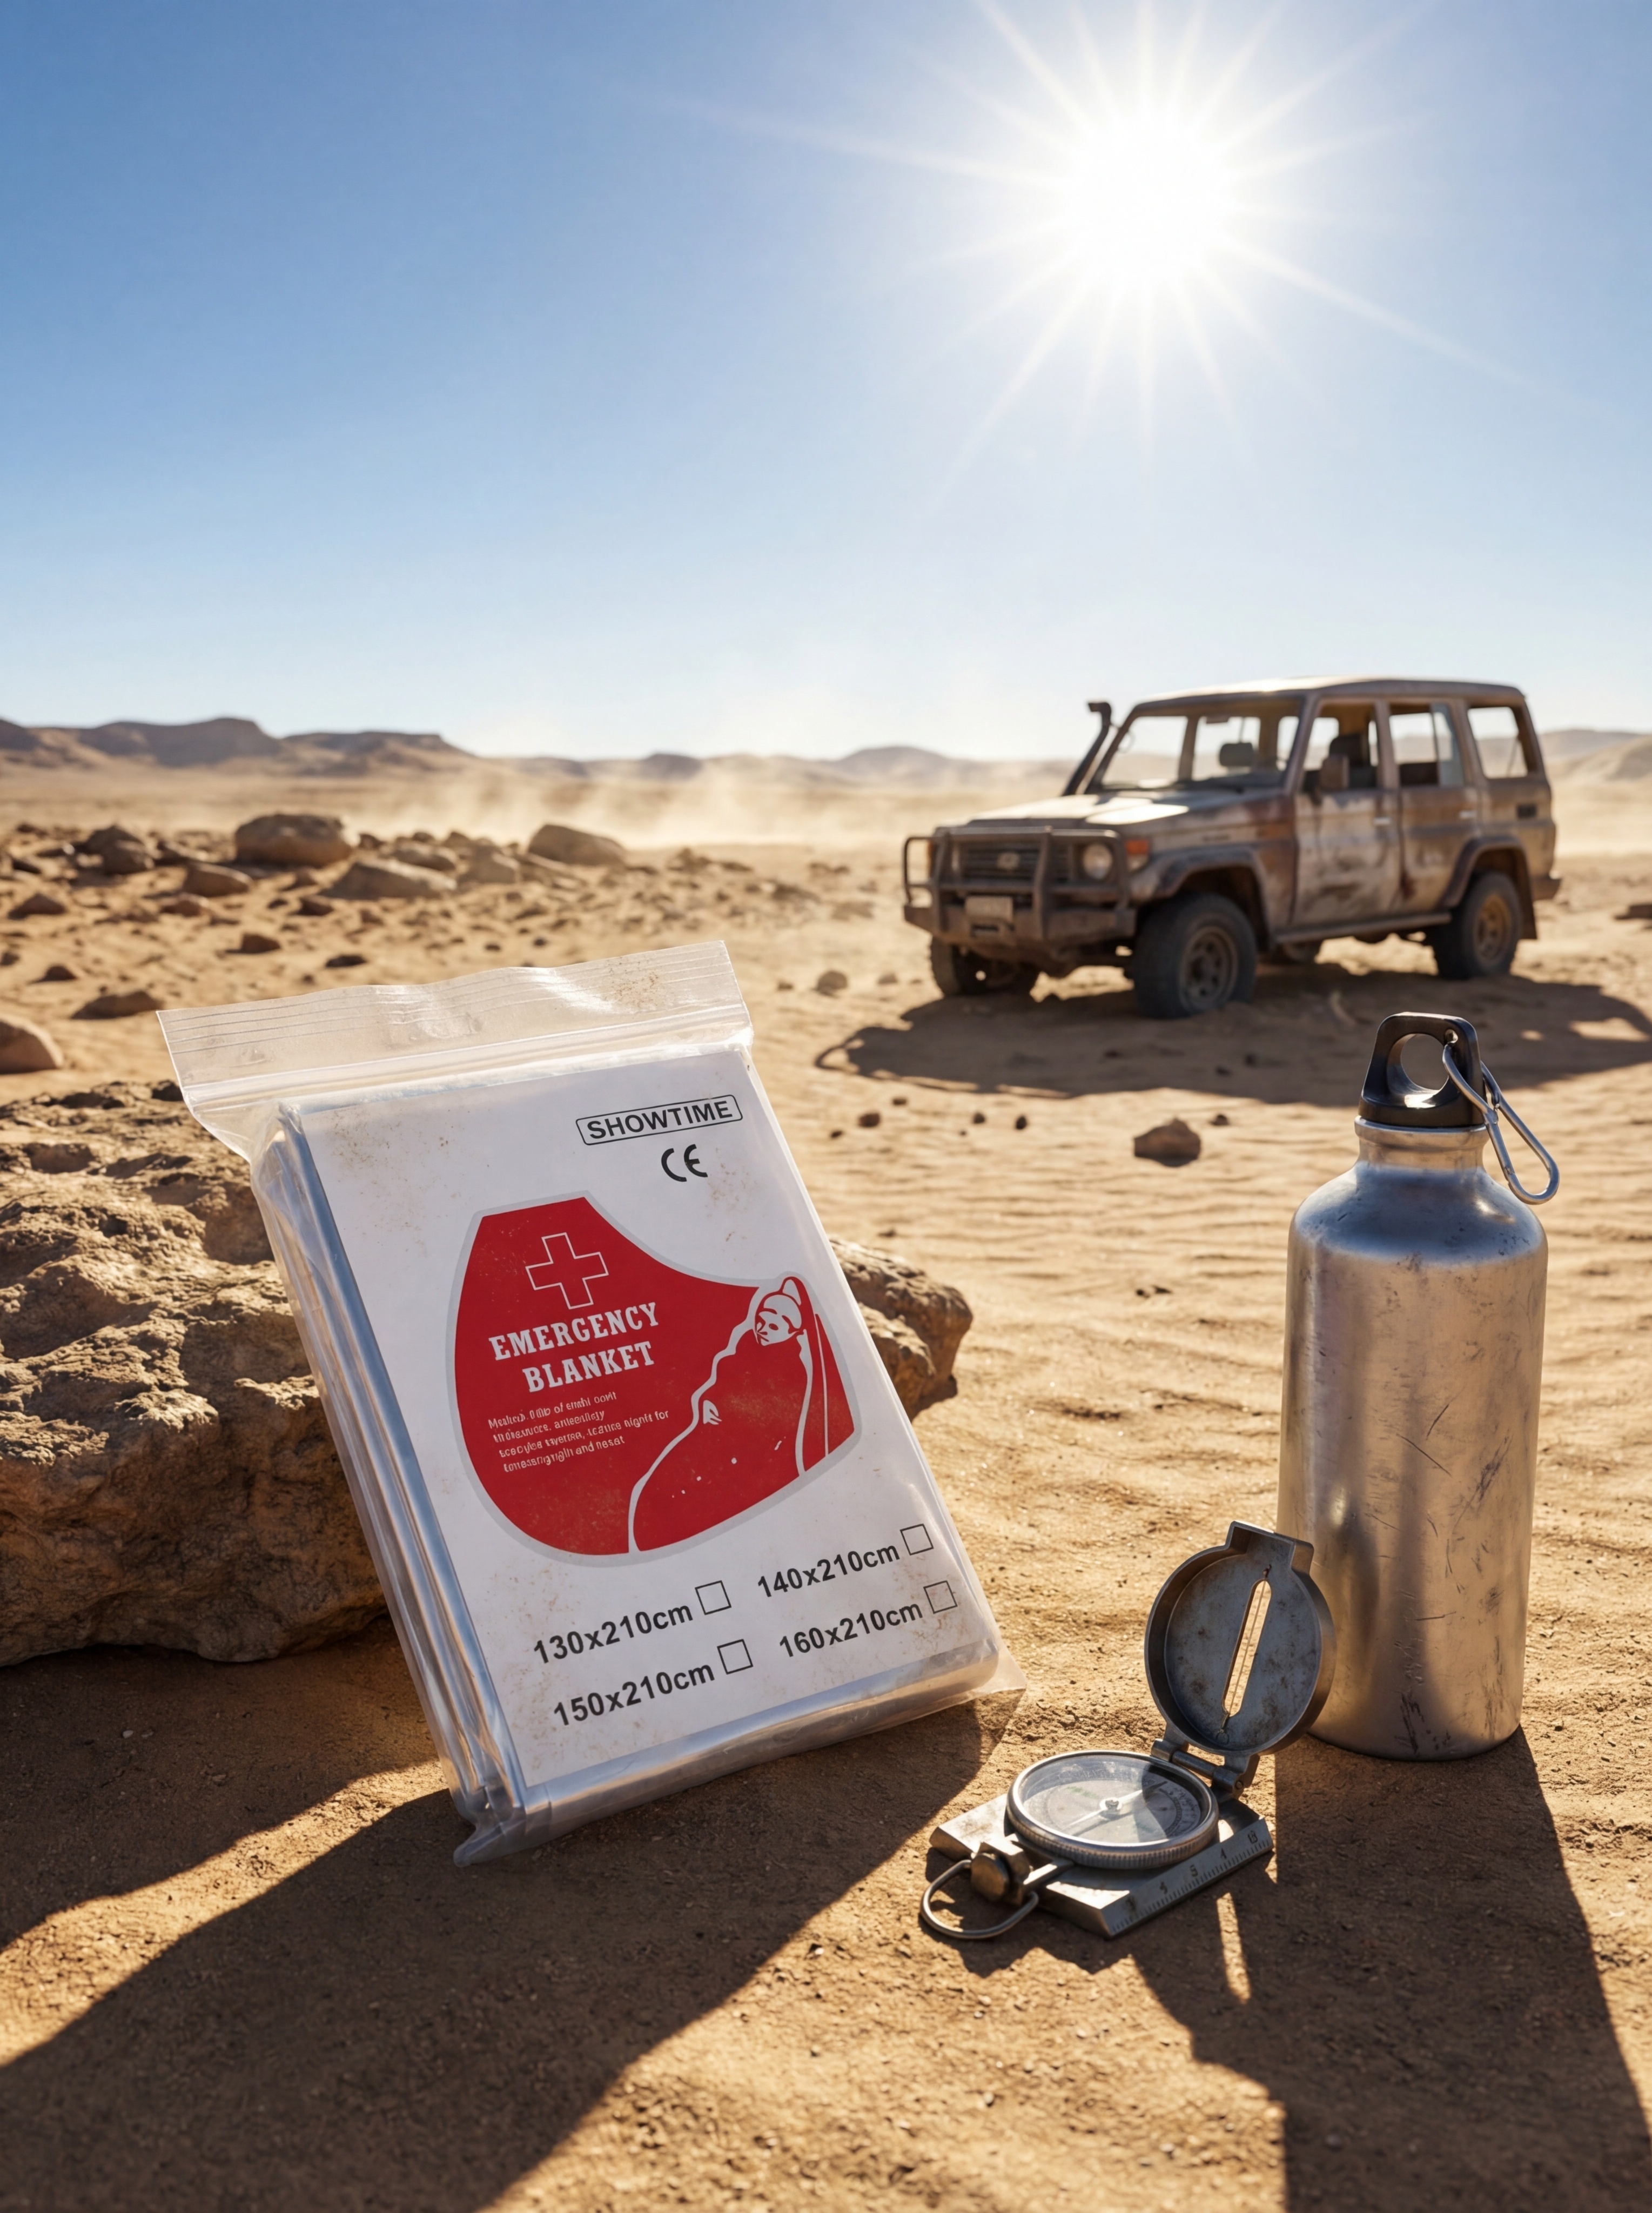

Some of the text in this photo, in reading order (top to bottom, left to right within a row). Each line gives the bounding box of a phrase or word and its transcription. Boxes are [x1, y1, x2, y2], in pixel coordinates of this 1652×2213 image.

[587, 1101, 733, 1139] SHOWTIME
[661, 1144, 708, 1182] CE
[488, 1302, 659, 1360] EMERGENCY
[522, 1341, 654, 1393] BLANKET
[654, 1410, 669, 1420] for
[575, 1441, 595, 1455] and
[757, 1545, 900, 1598] 140x210cm
[534, 1605, 693, 1664] 130x210cm
[780, 1604, 923, 1658] 160x210cm
[554, 1665, 715, 1726] 150x210cm
